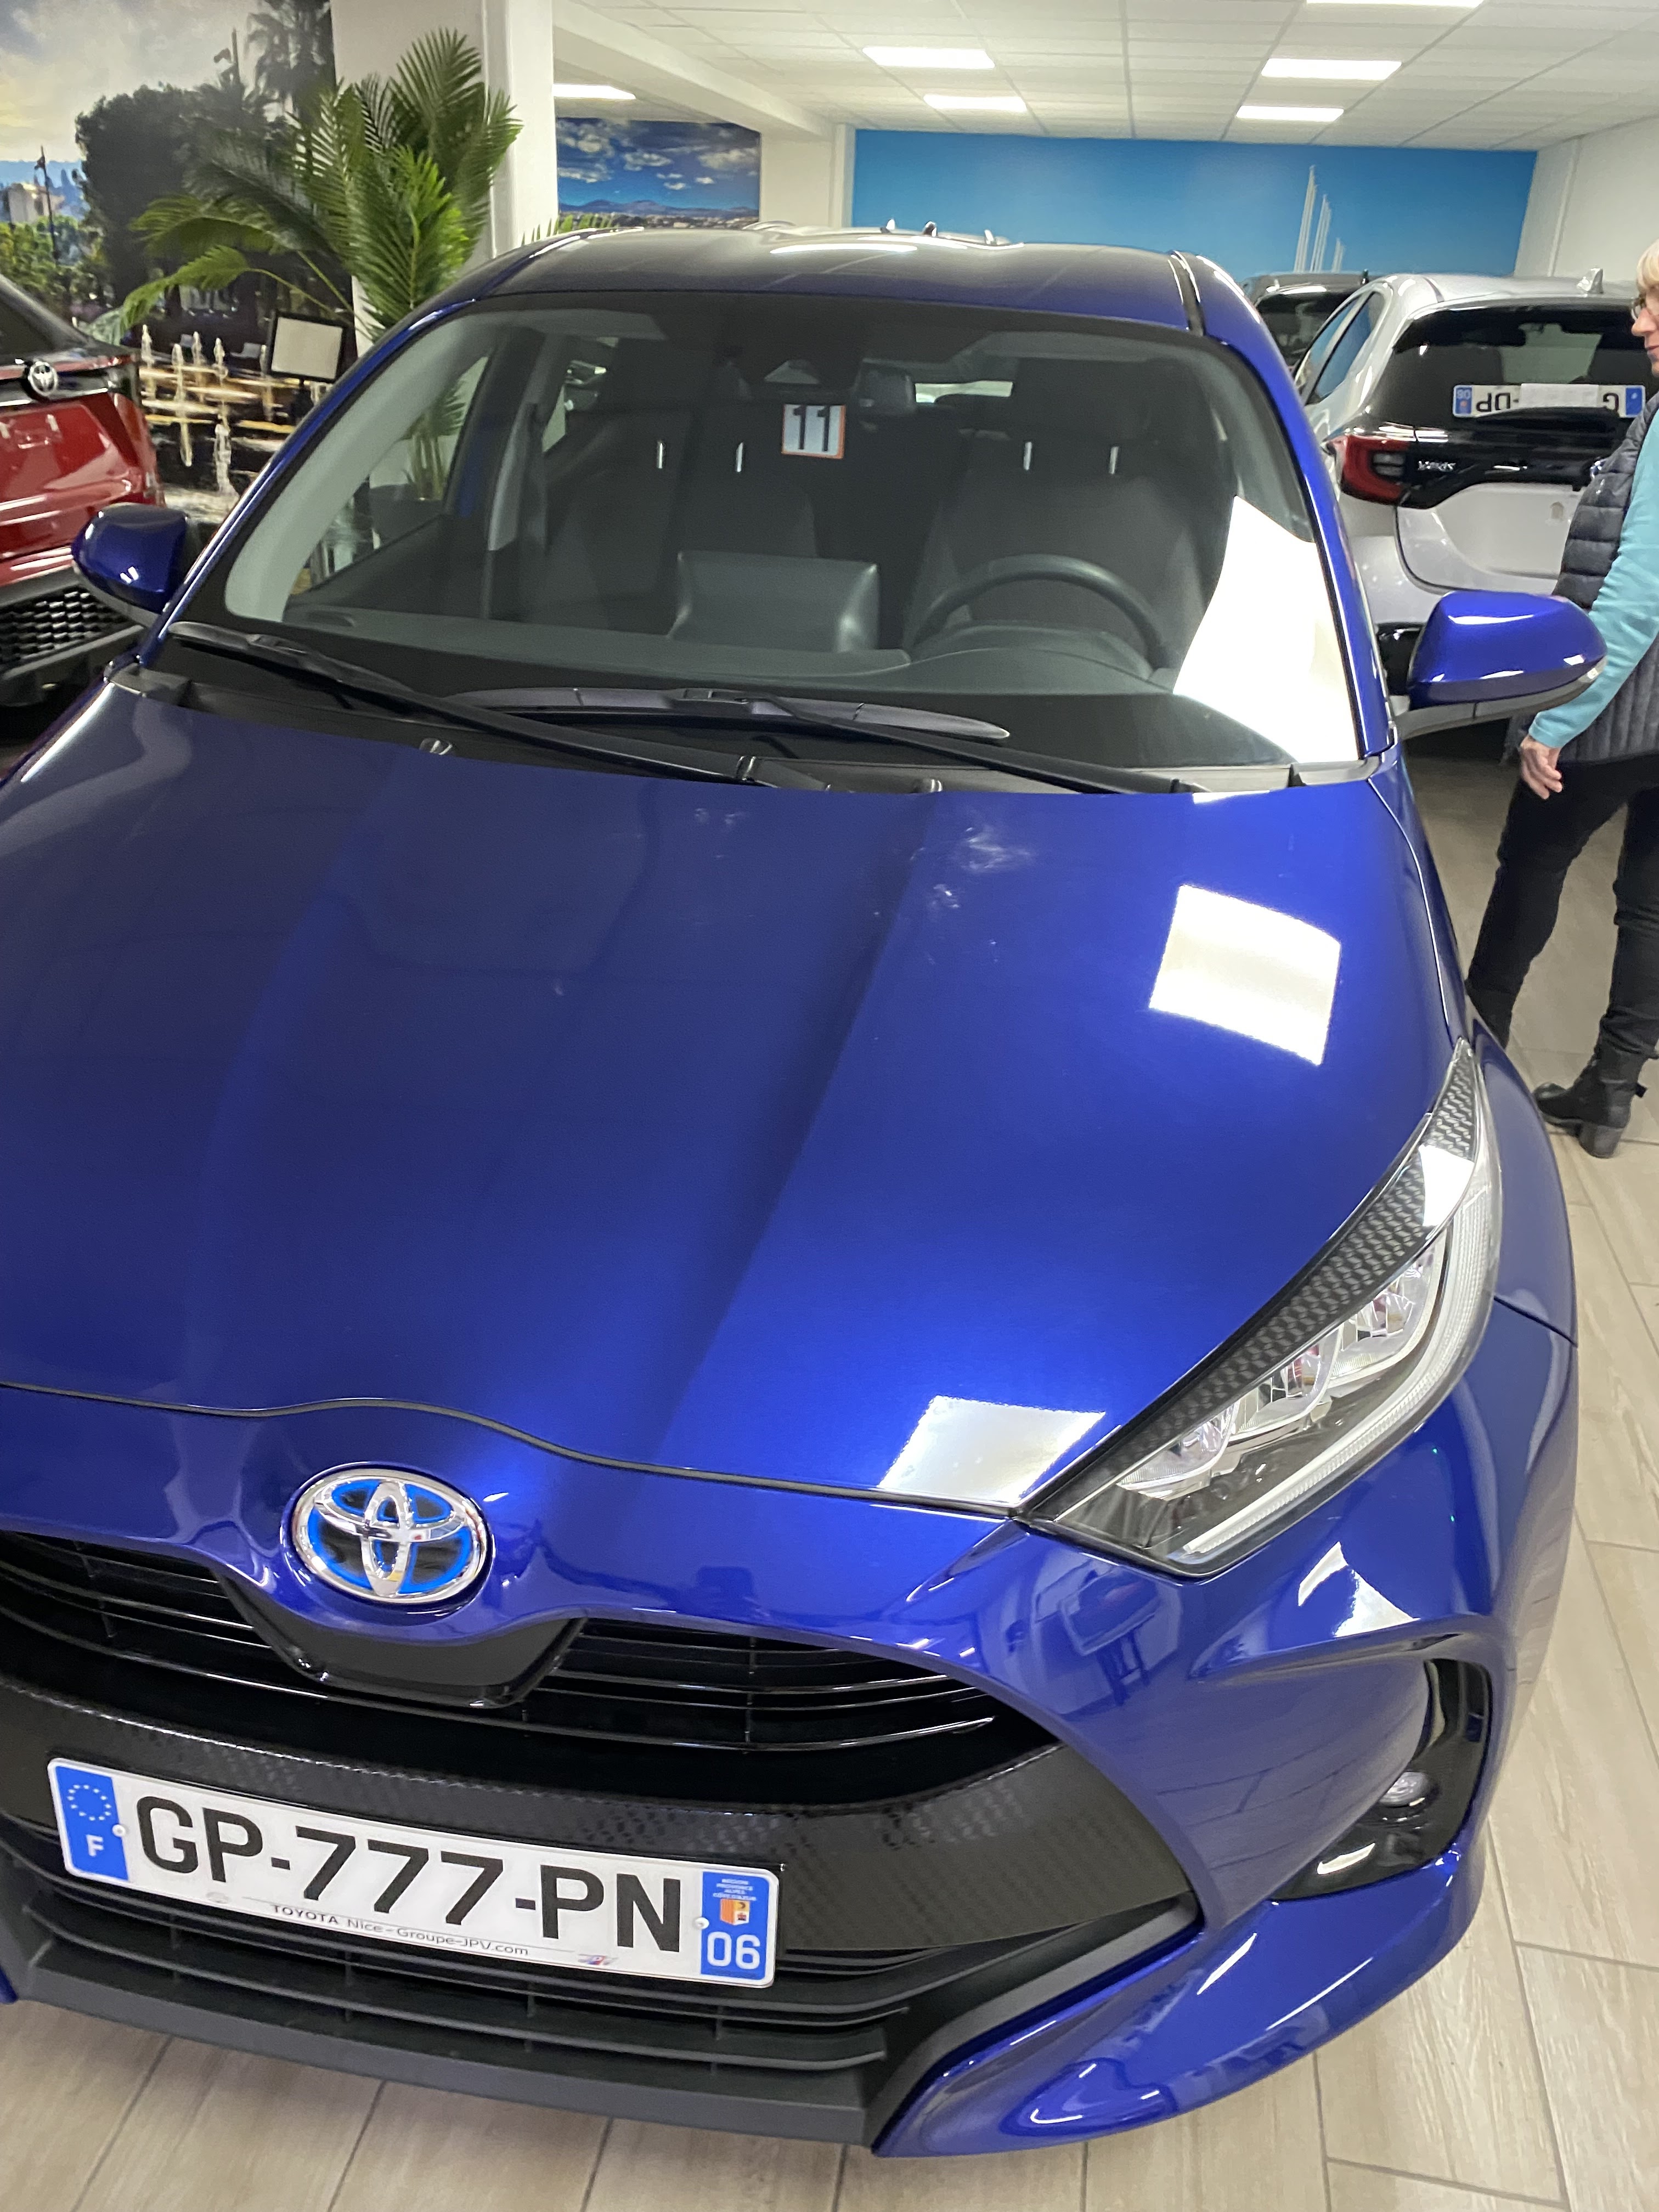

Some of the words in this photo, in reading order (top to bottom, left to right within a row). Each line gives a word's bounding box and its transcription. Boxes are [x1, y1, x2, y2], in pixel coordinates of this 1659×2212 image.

[792, 404, 830, 452] 11
[86, 1835, 104, 1857] F
[136, 1796, 681, 1953] GP-777-PN
[272, 1904, 338, 1925] TOYOTA
[707, 1931, 760, 1970] 06
